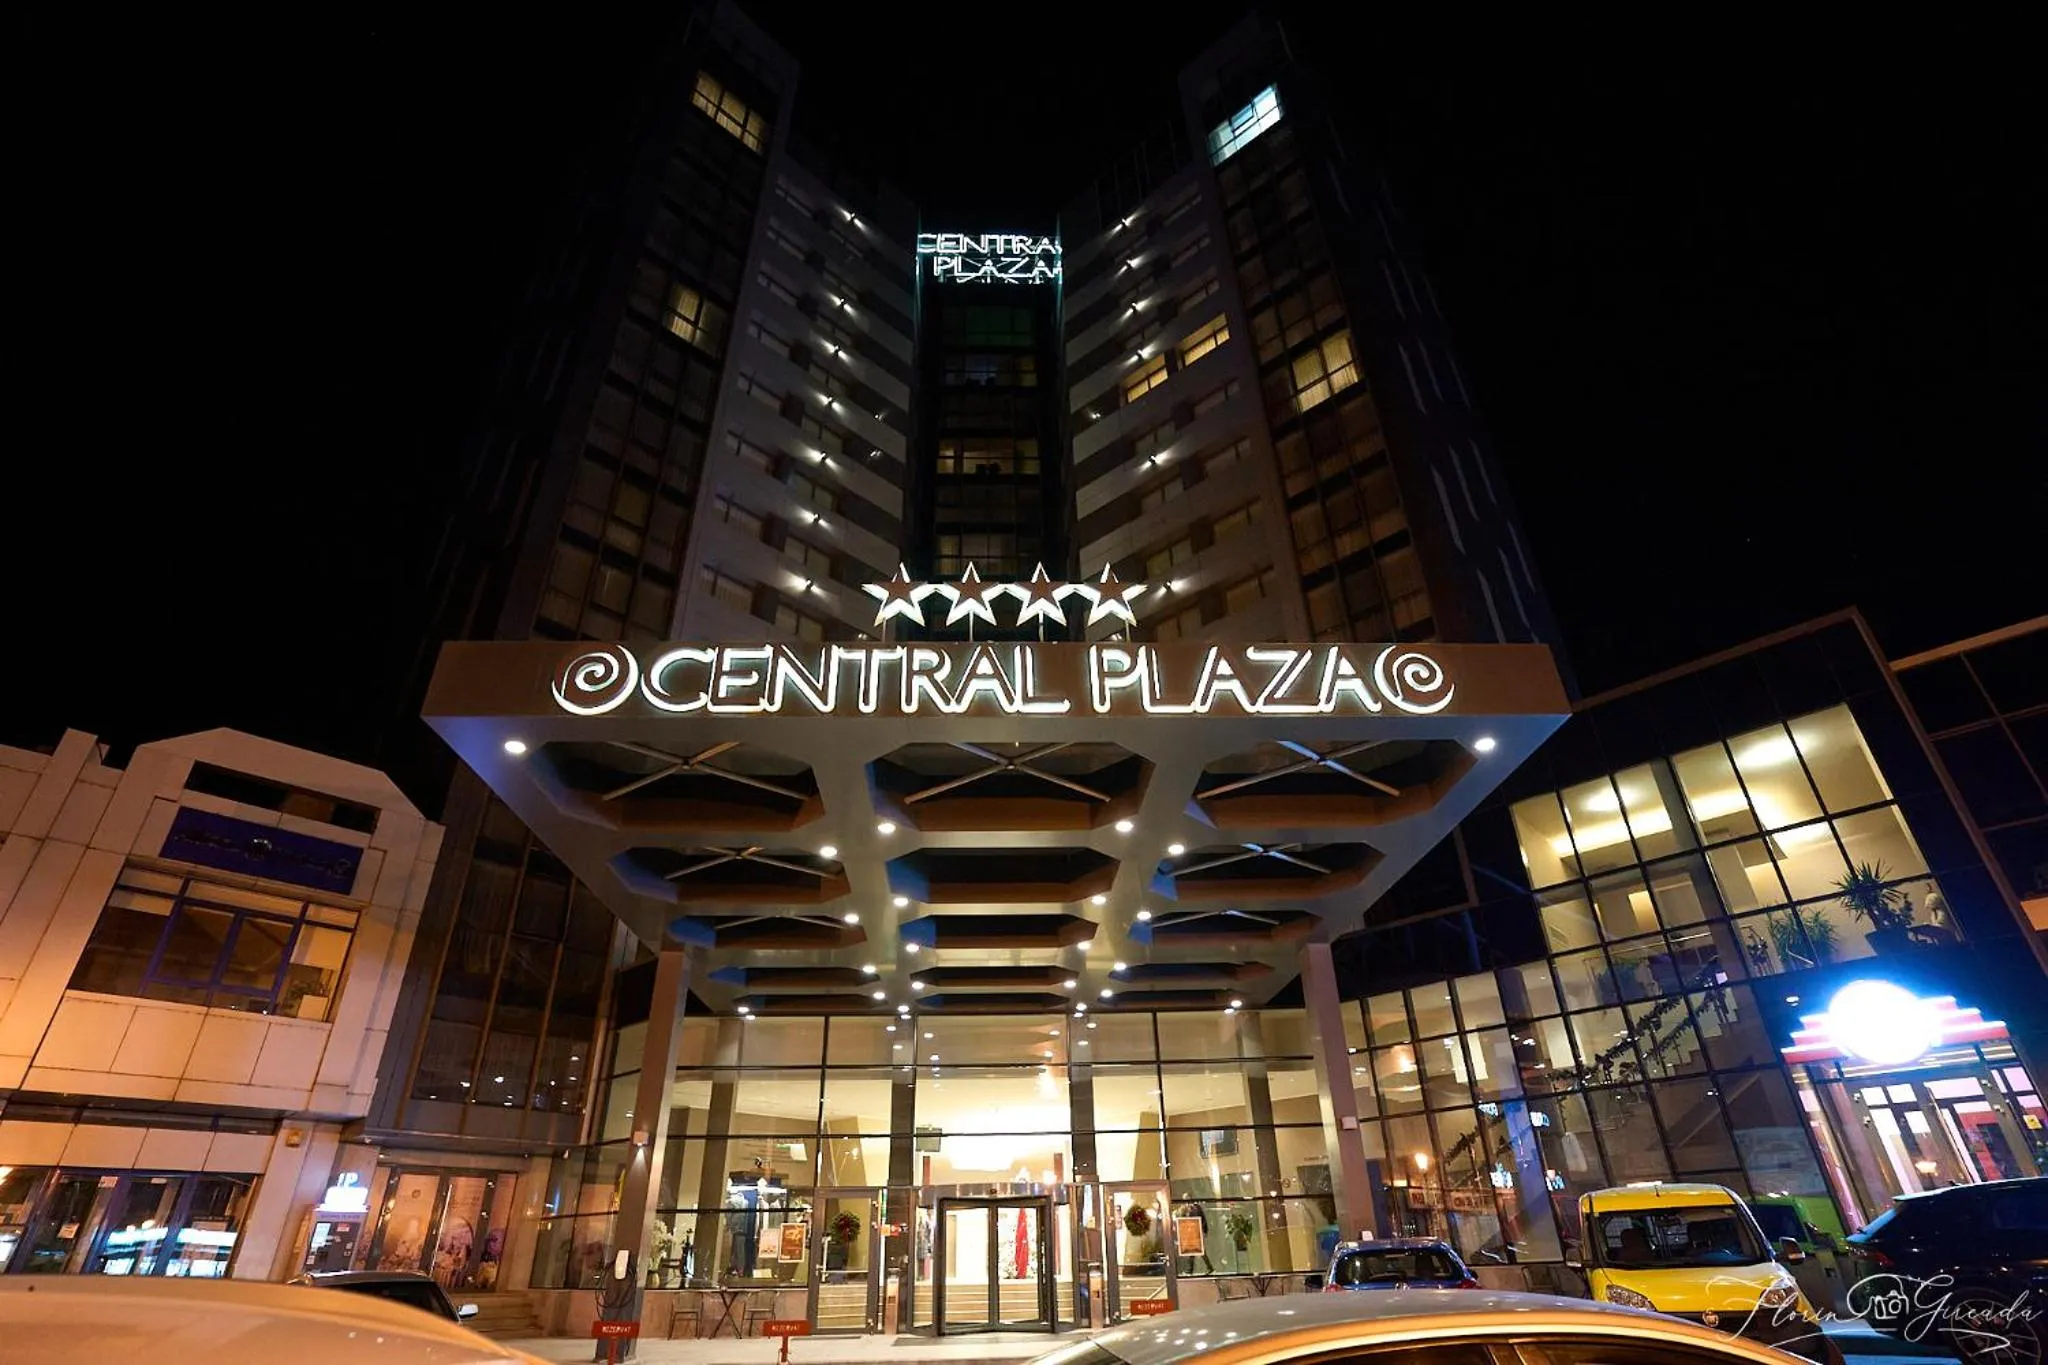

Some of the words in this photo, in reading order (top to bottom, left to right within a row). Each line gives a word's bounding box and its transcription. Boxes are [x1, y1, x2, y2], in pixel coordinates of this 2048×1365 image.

[933, 256, 1054, 277] PLAZA
[641, 644, 1070, 713] CENTRAL
[1089, 644, 1382, 713] PLAZA
